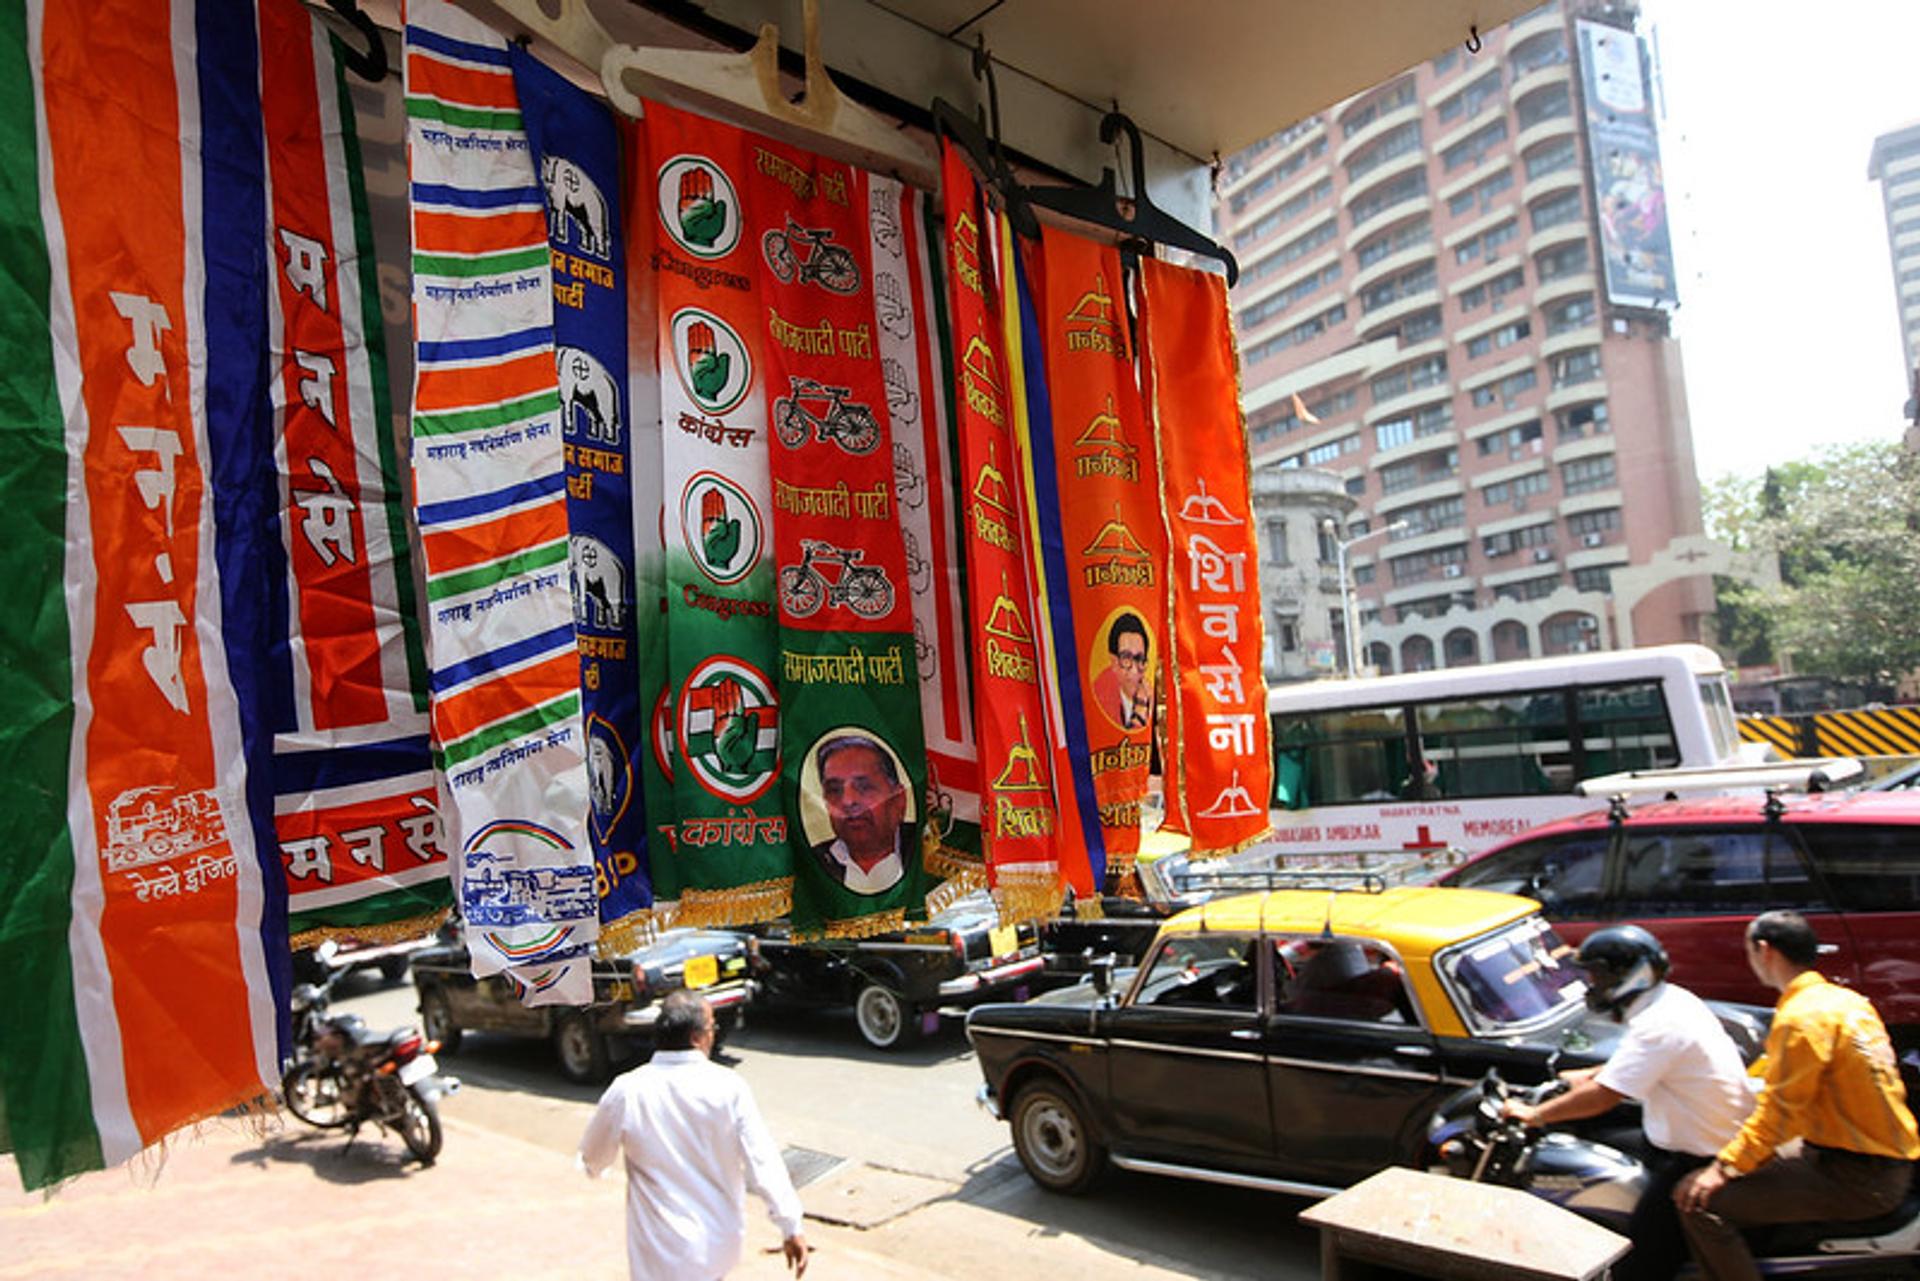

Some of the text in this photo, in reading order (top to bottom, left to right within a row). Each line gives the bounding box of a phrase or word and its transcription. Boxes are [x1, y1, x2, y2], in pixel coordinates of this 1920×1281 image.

[682, 584, 771, 621] Congress
[1187, 533, 1257, 757] शिवसेना
[682, 807, 788, 848] कांग्रेस
